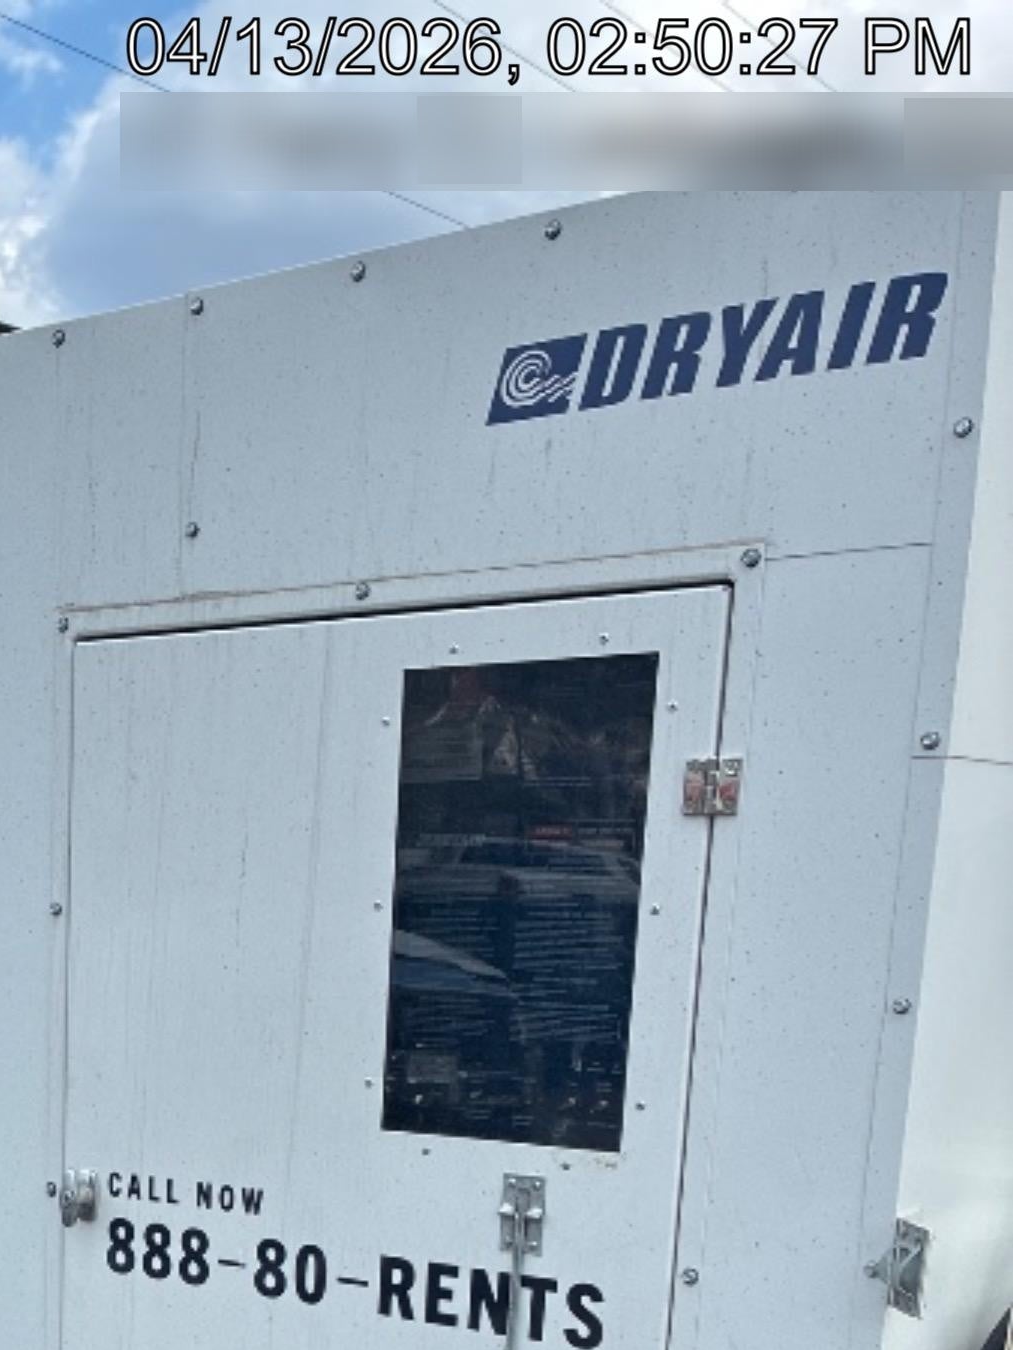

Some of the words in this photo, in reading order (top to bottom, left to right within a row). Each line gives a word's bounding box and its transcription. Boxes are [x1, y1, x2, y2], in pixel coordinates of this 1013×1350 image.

[578, 271, 949, 412] DRYAIR
[107, 1171, 181, 1206] CALL
[196, 1181, 265, 1217] NOW
[106, 1217, 605, 1350] 888-80-RENTS
